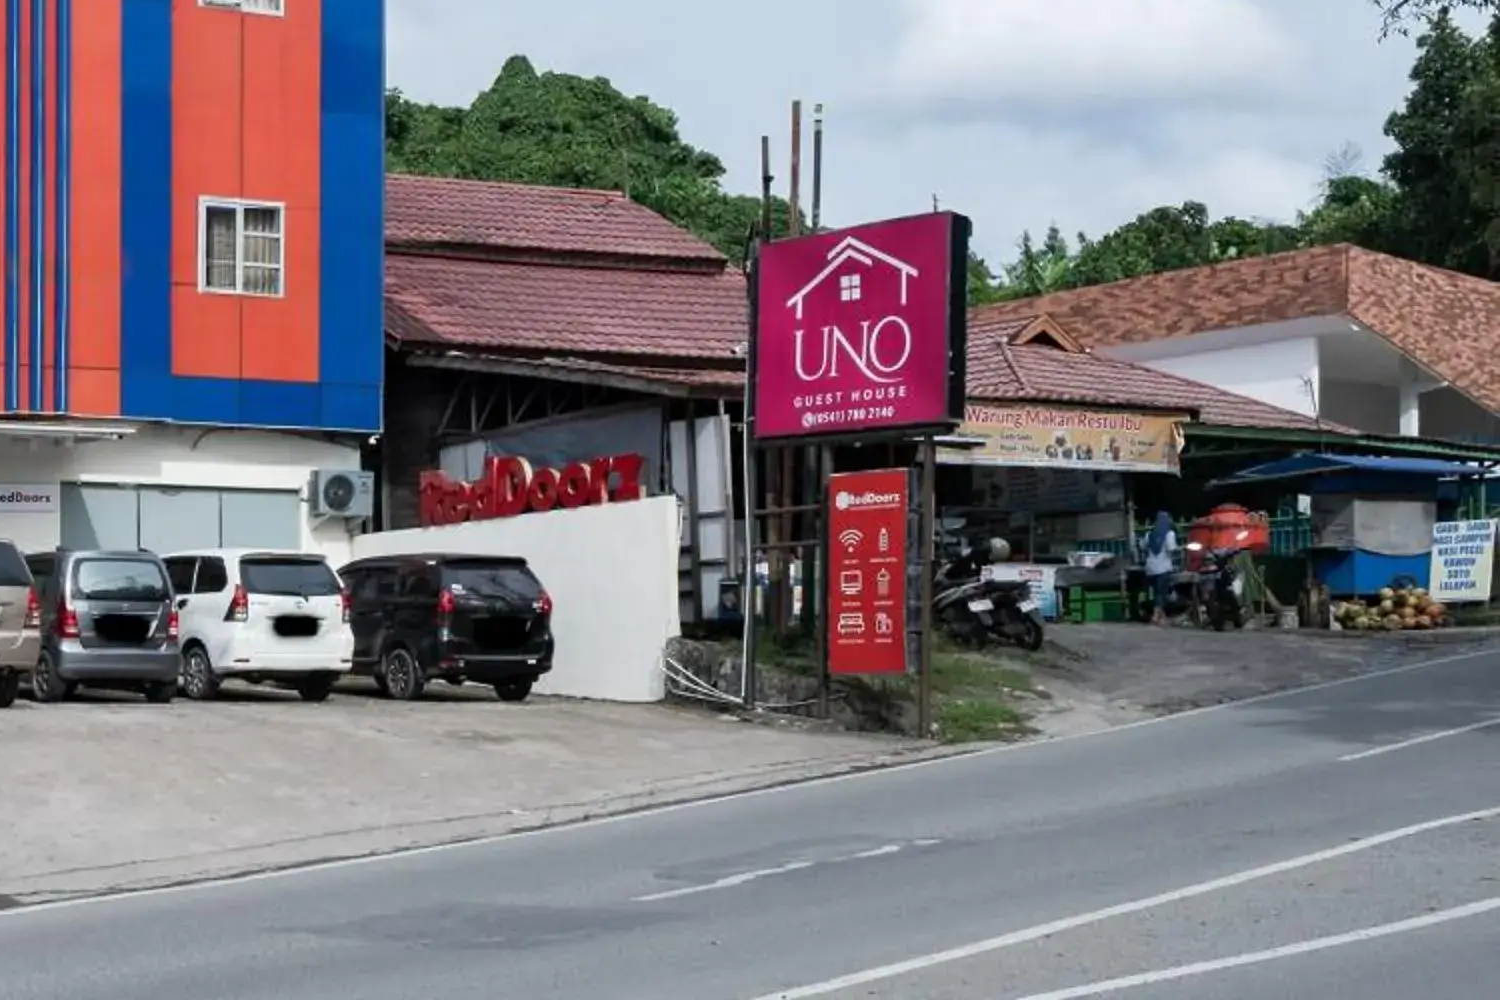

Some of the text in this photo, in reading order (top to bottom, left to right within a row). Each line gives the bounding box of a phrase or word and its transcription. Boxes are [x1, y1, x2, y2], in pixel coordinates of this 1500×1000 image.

[794, 315, 911, 383] UNO
[793, 385, 907, 408] GUEST HOUSE
[967, 406, 1022, 429] Warung
[1025, 409, 1075, 427] Makan
[1078, 413, 1117, 429] Restu
[420, 453, 645, 528] RedDoorz
